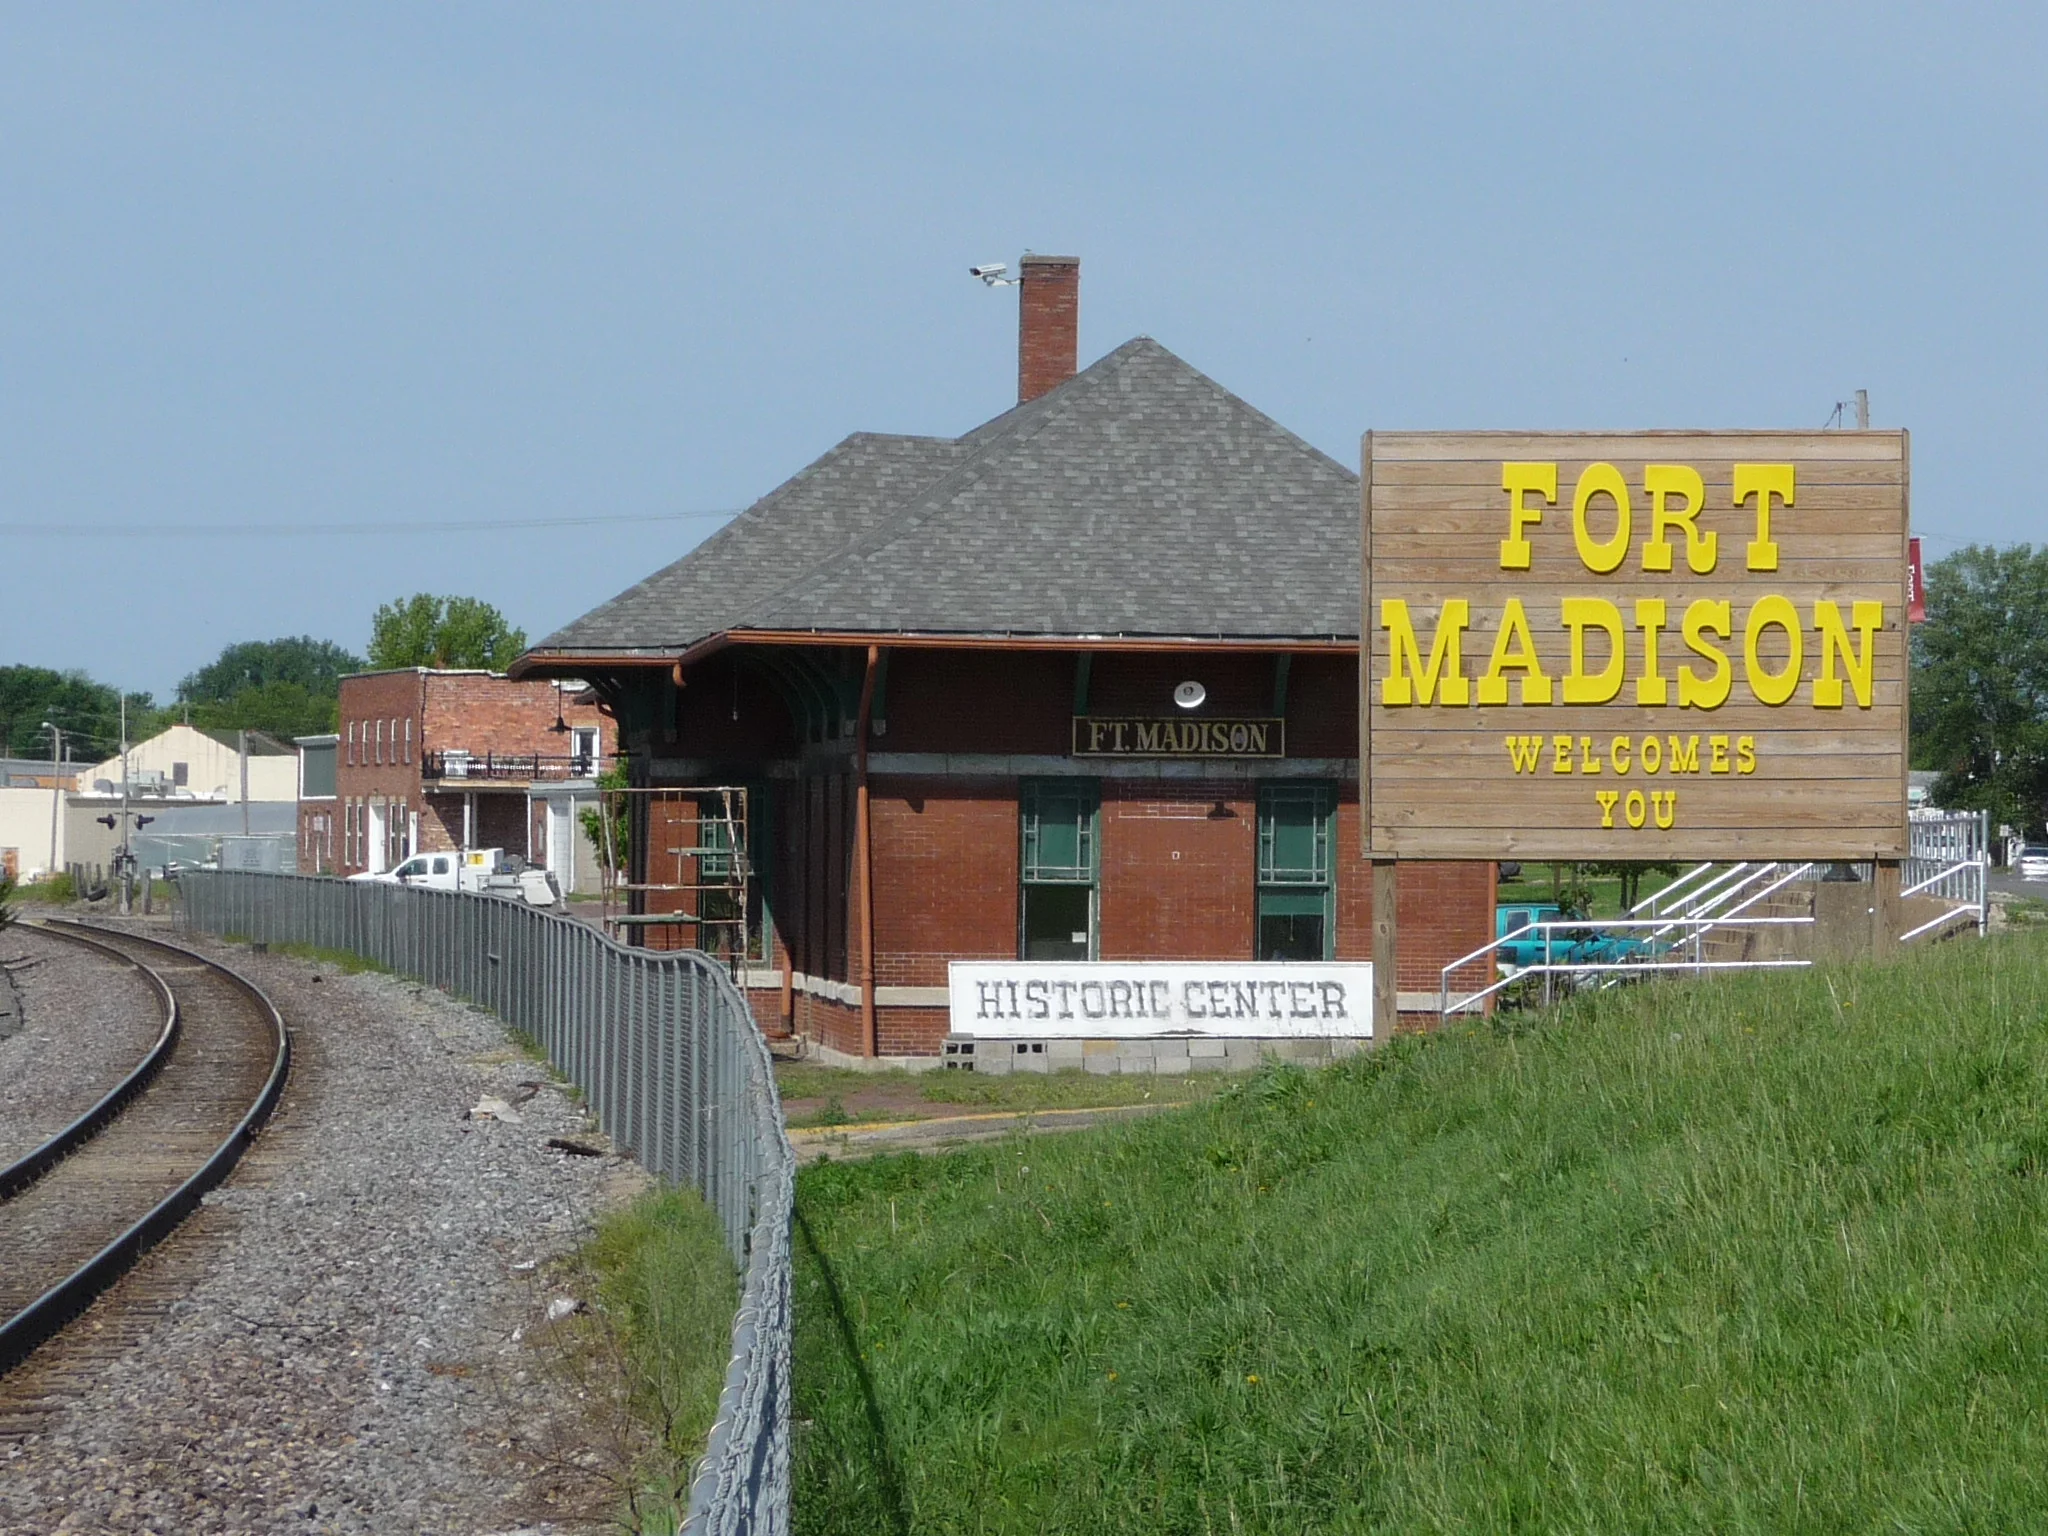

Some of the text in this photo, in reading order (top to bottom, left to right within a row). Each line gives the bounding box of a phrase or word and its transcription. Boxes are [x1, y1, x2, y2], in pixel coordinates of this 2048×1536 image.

[1500, 463, 1796, 573] FORT
[1381, 595, 1883, 709] MADISON
[1088, 721, 1269, 754] FT. MADISON
[1506, 735, 1757, 774] WELCOMES
[1596, 790, 1677, 829] YOU
[975, 979, 1349, 1020] HISTORIC CENTER
